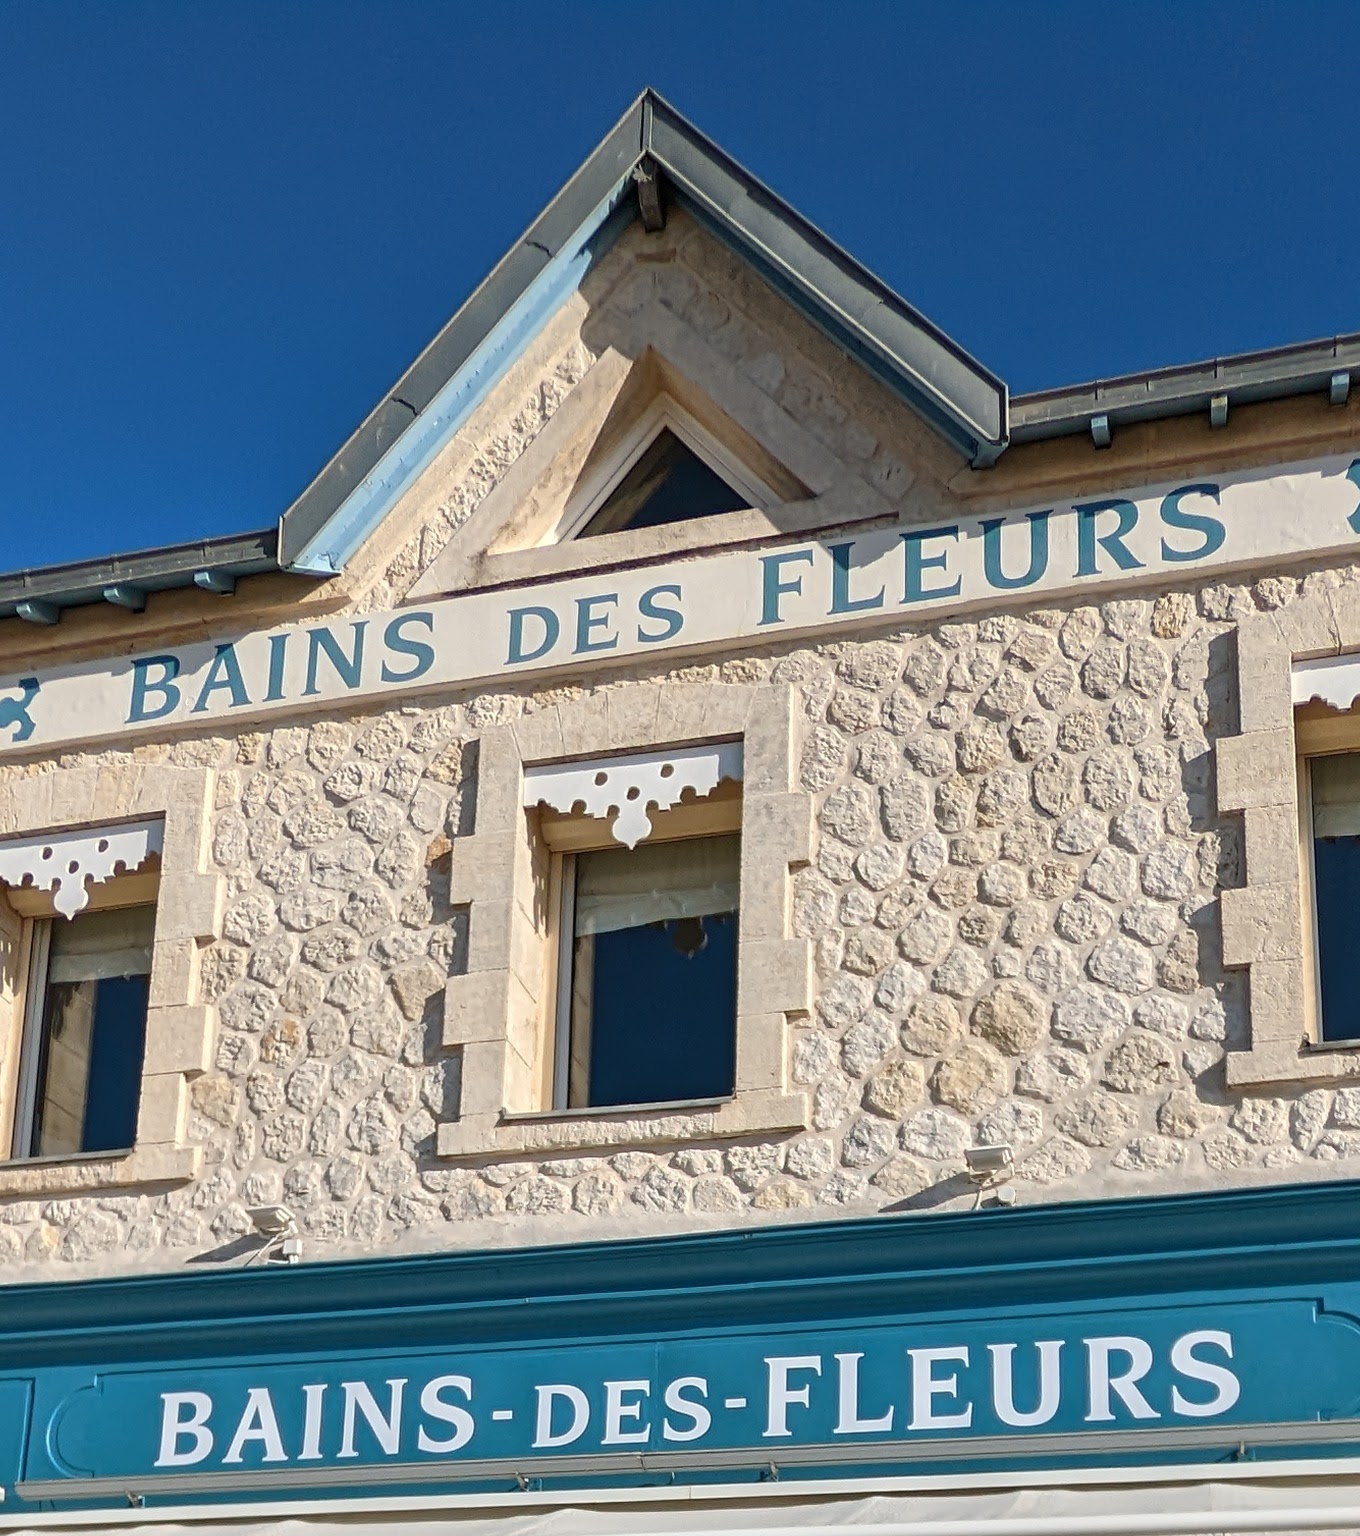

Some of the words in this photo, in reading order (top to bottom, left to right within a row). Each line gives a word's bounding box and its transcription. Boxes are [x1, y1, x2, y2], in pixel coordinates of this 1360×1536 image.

[124, 610, 436, 724] BAINS
[502, 583, 684, 666] DES
[757, 482, 1227, 627] FLEURS
